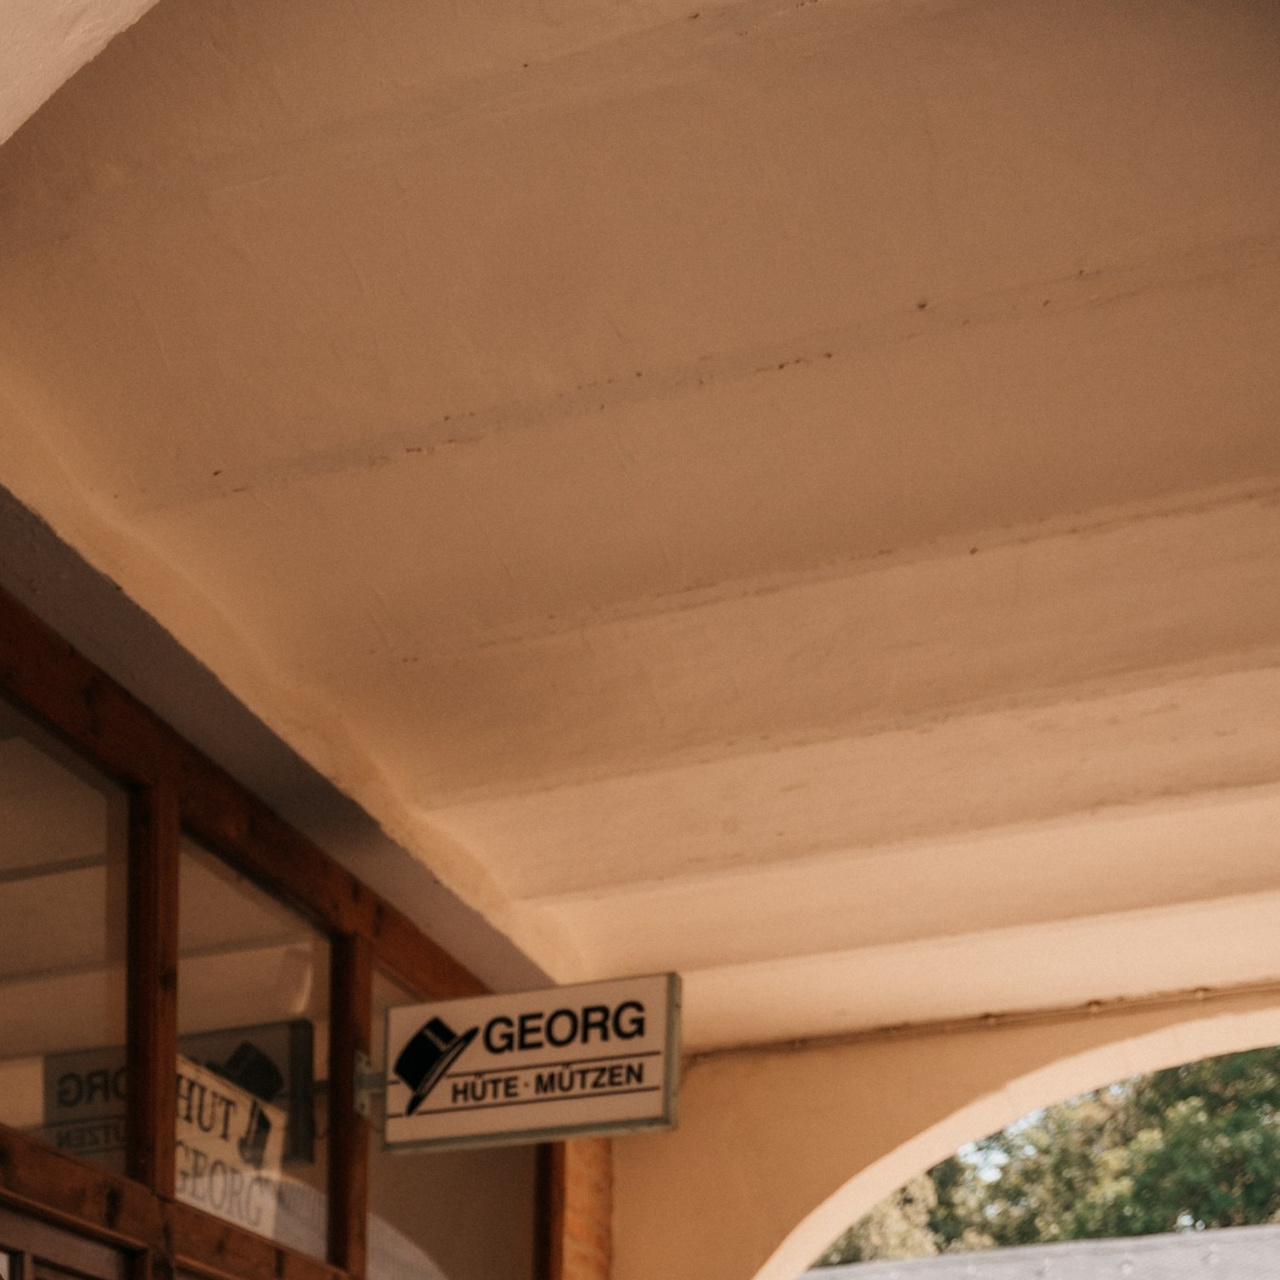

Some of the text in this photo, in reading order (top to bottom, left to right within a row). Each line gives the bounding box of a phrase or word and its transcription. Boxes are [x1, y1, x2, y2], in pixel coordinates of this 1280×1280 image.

[483, 1000, 646, 1054] GEORG
[176, 1073, 236, 1142] HUT
[451, 1063, 644, 1103] HÜTE MÜTZEN
[175, 1141, 274, 1228] GEORG
